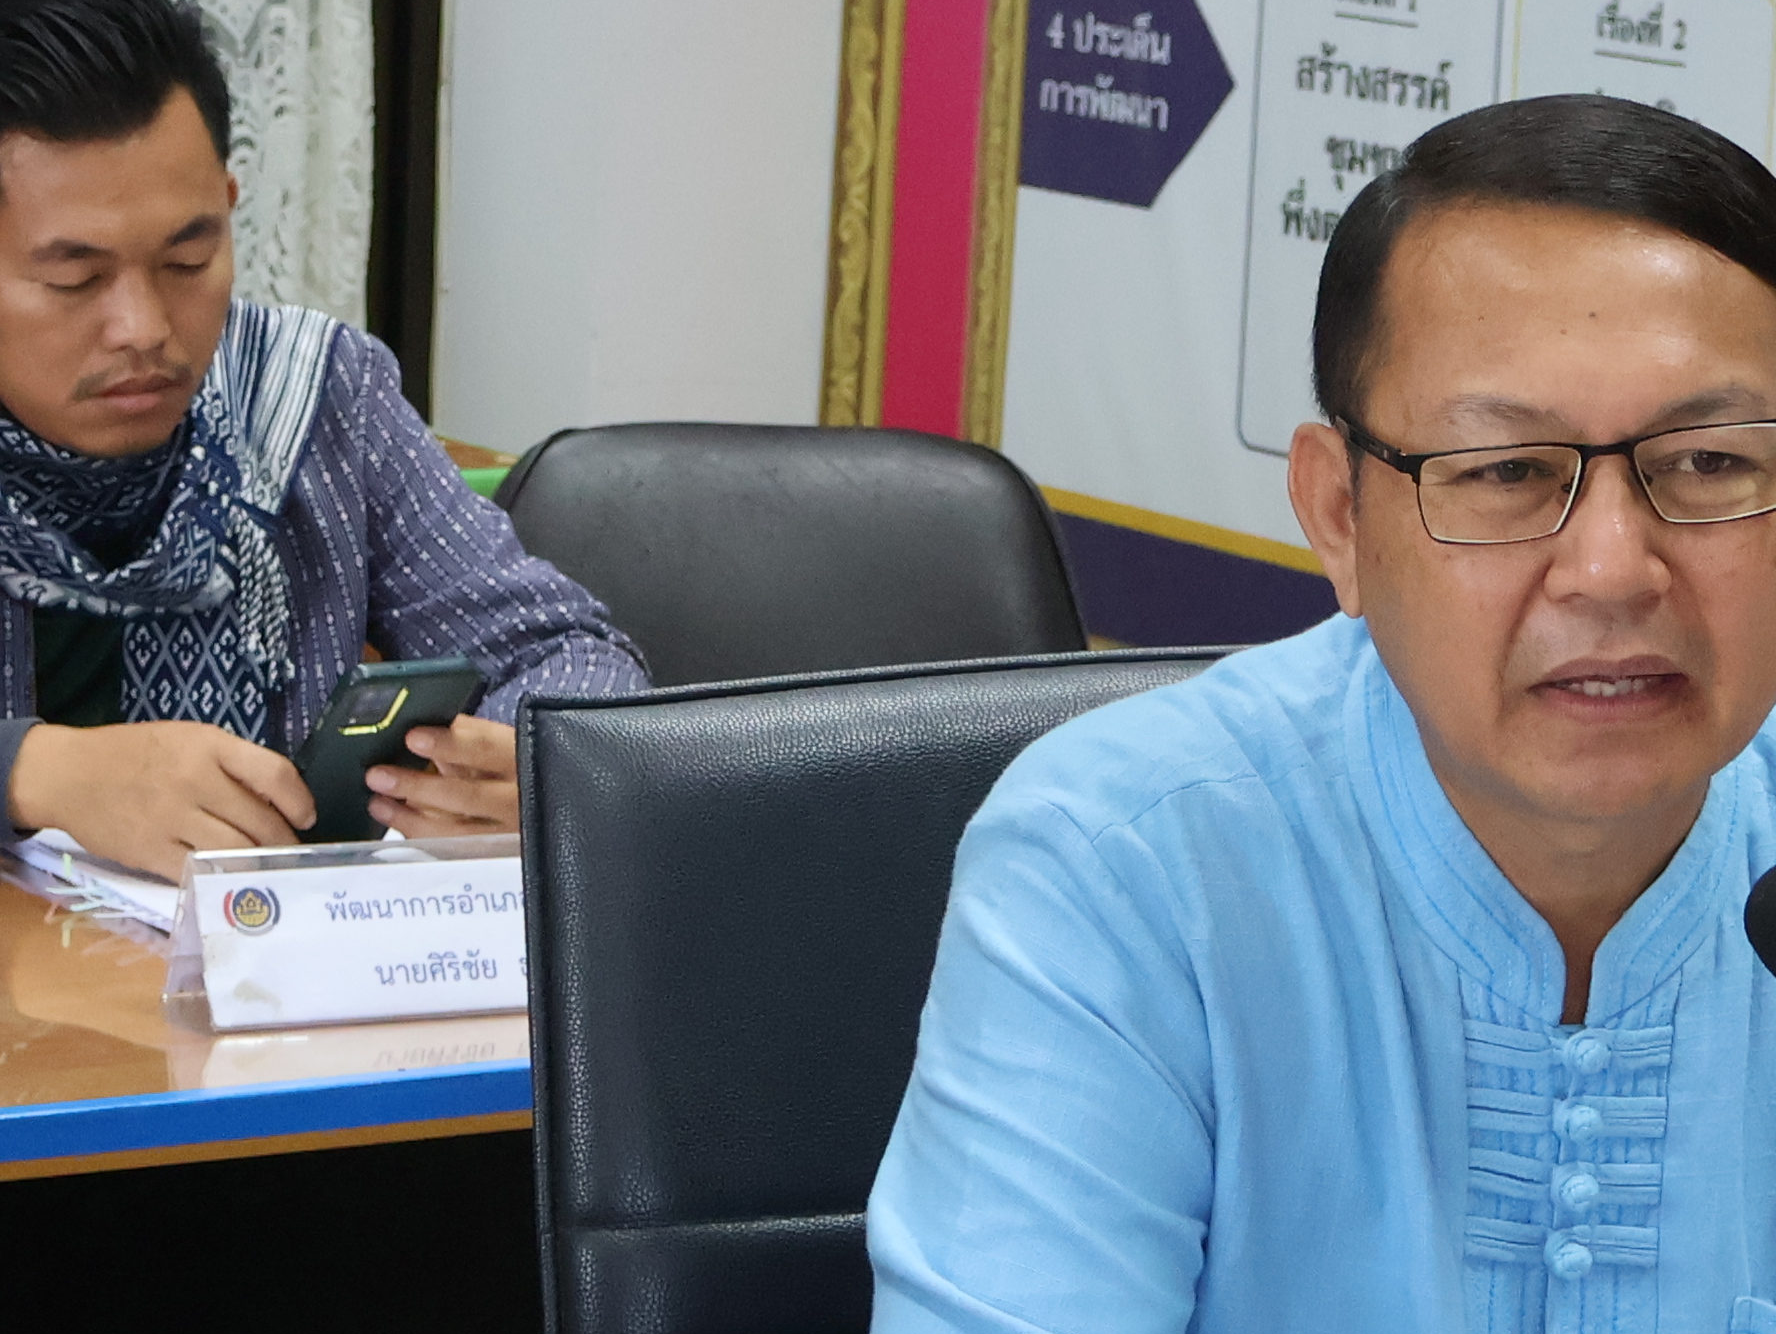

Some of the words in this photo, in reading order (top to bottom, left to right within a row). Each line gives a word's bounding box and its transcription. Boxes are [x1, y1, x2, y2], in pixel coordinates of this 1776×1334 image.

[1045, 12, 1065, 48] 4
[1073, 12, 1172, 65] ประเด็น
[1672, 19, 1687, 50] 2
[1039, 75, 1169, 131] การพัฒนา
[1296, 43, 1453, 112] สร้างสรรค์
[1325, 135, 1408, 192] ชุมช
[374, 947, 498, 986] นายศิริชัย
